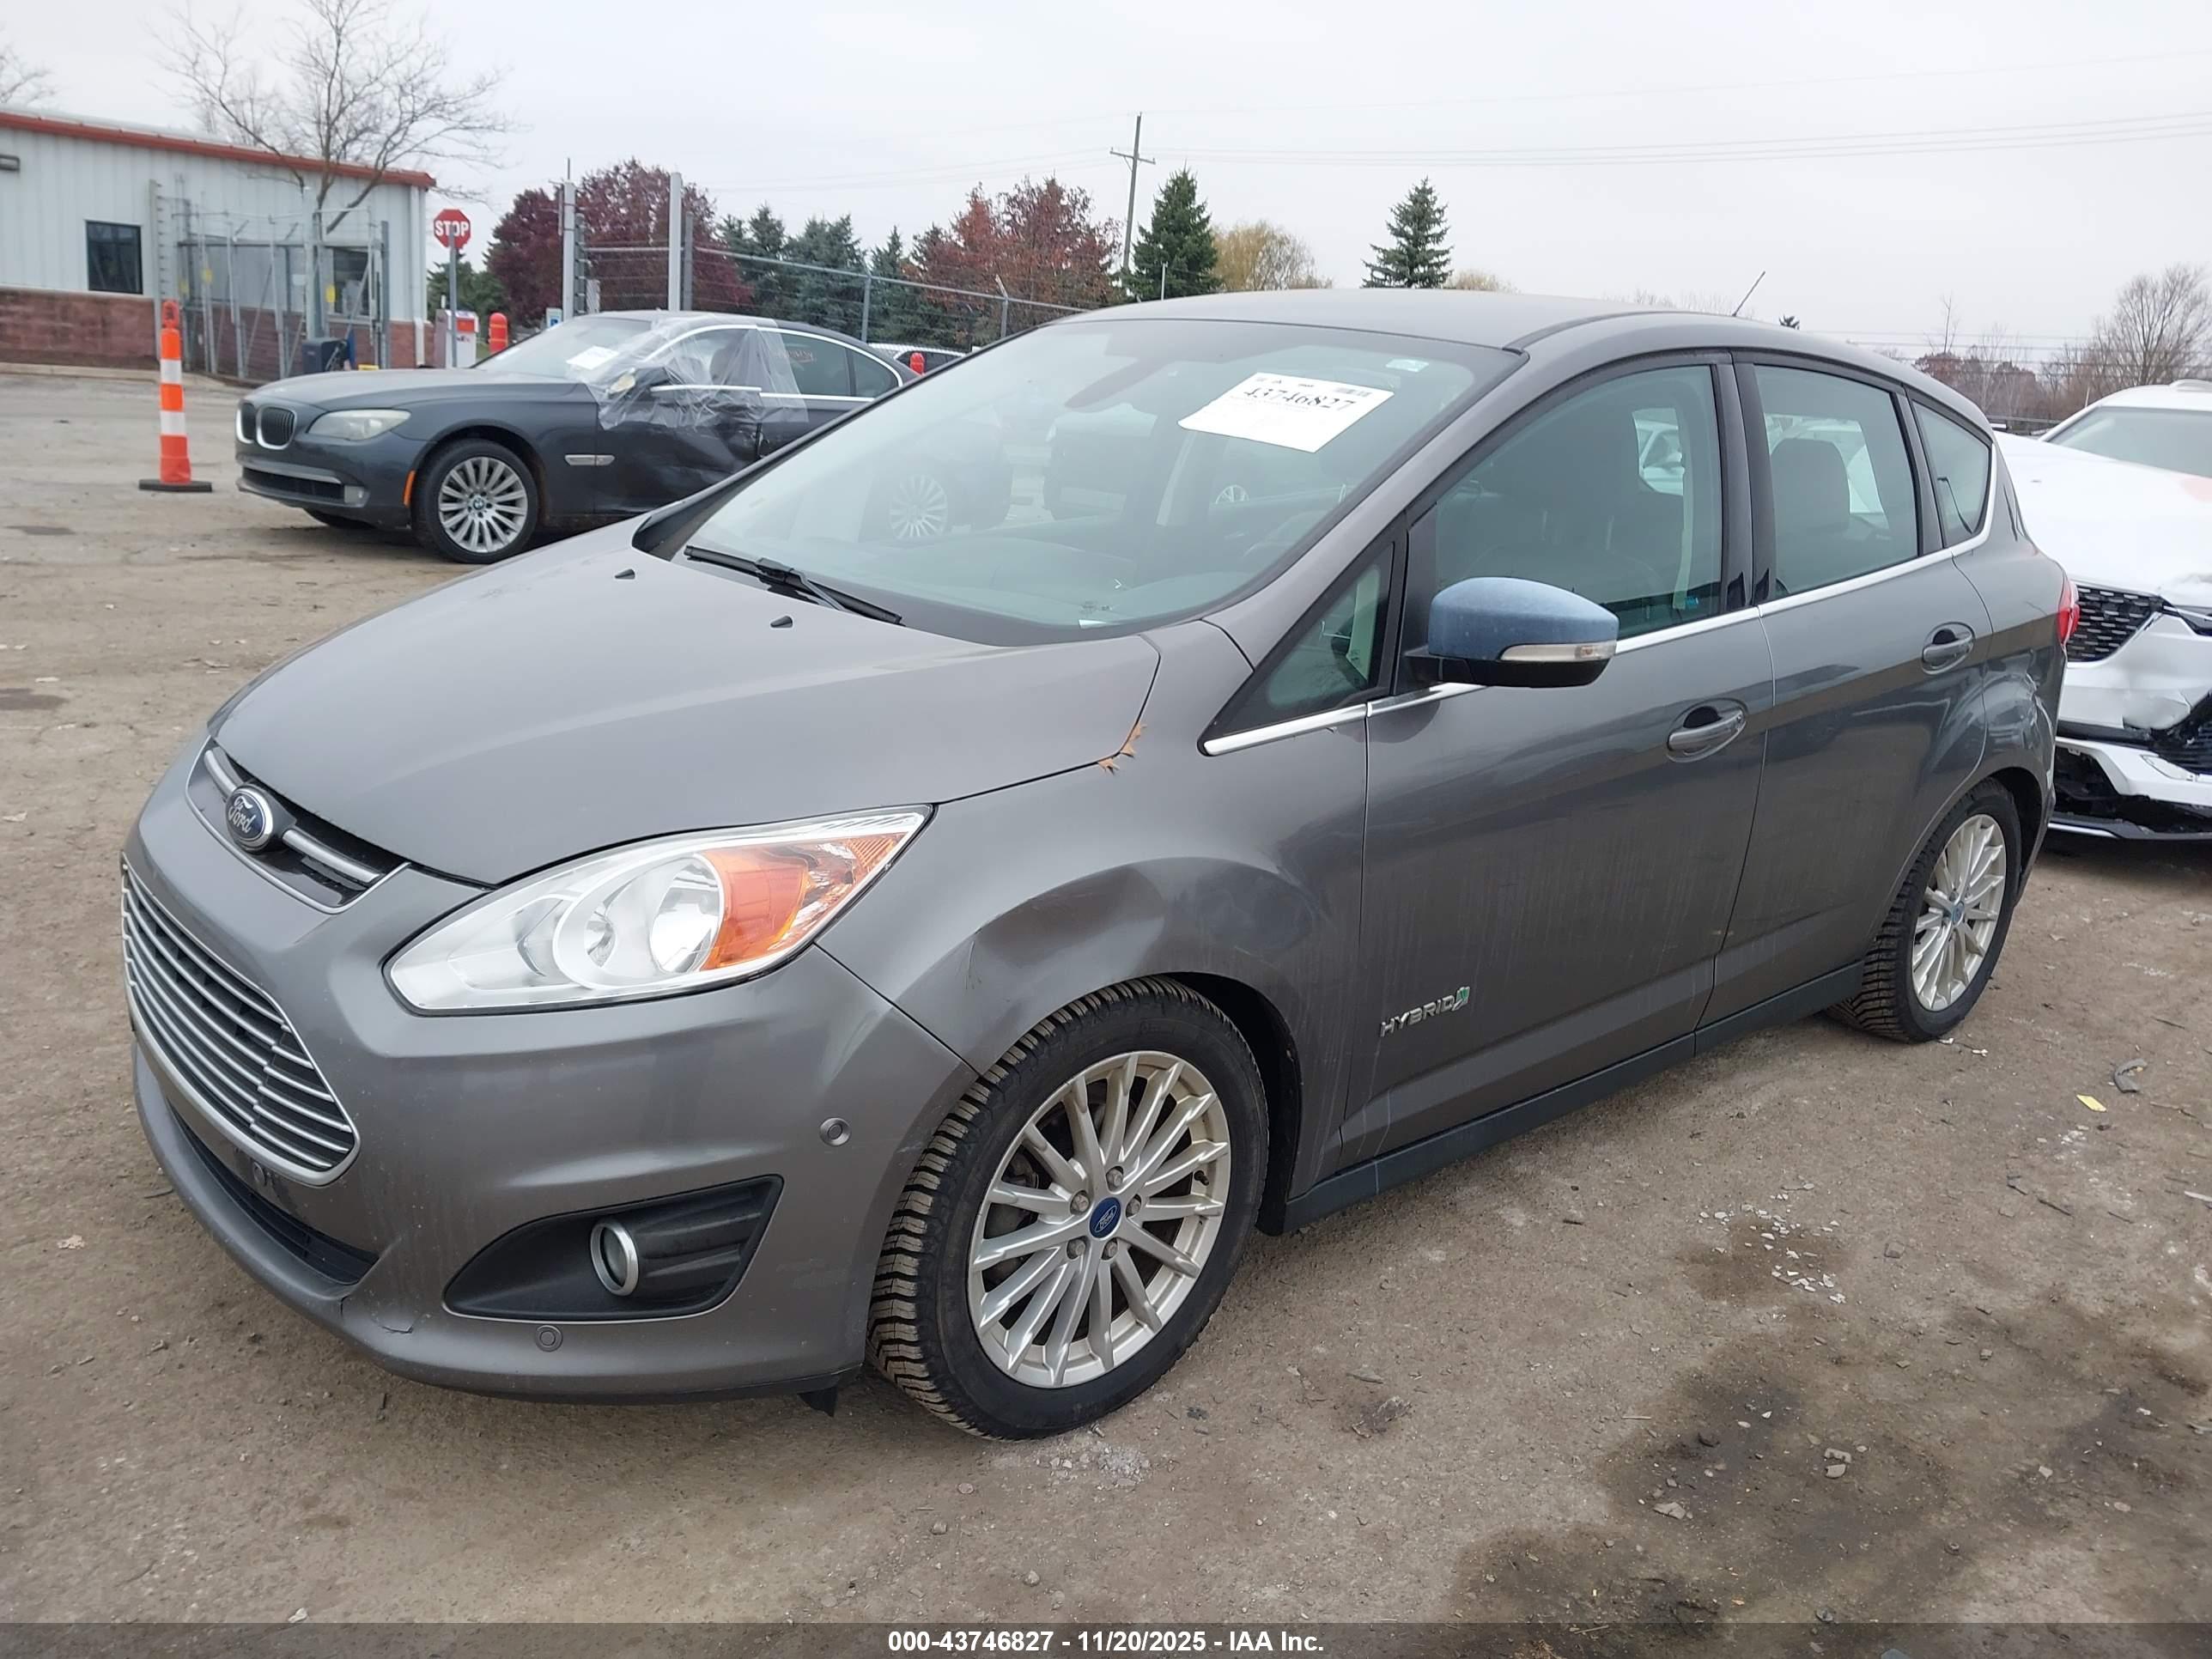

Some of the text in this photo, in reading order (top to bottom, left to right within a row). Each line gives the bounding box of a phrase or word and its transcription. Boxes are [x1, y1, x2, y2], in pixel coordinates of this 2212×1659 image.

[434, 220, 470, 238] STOP
[1243, 387, 1357, 411] 43746827
[228, 795, 257, 834] Ford
[1380, 994, 1455, 1037] HYBRID
